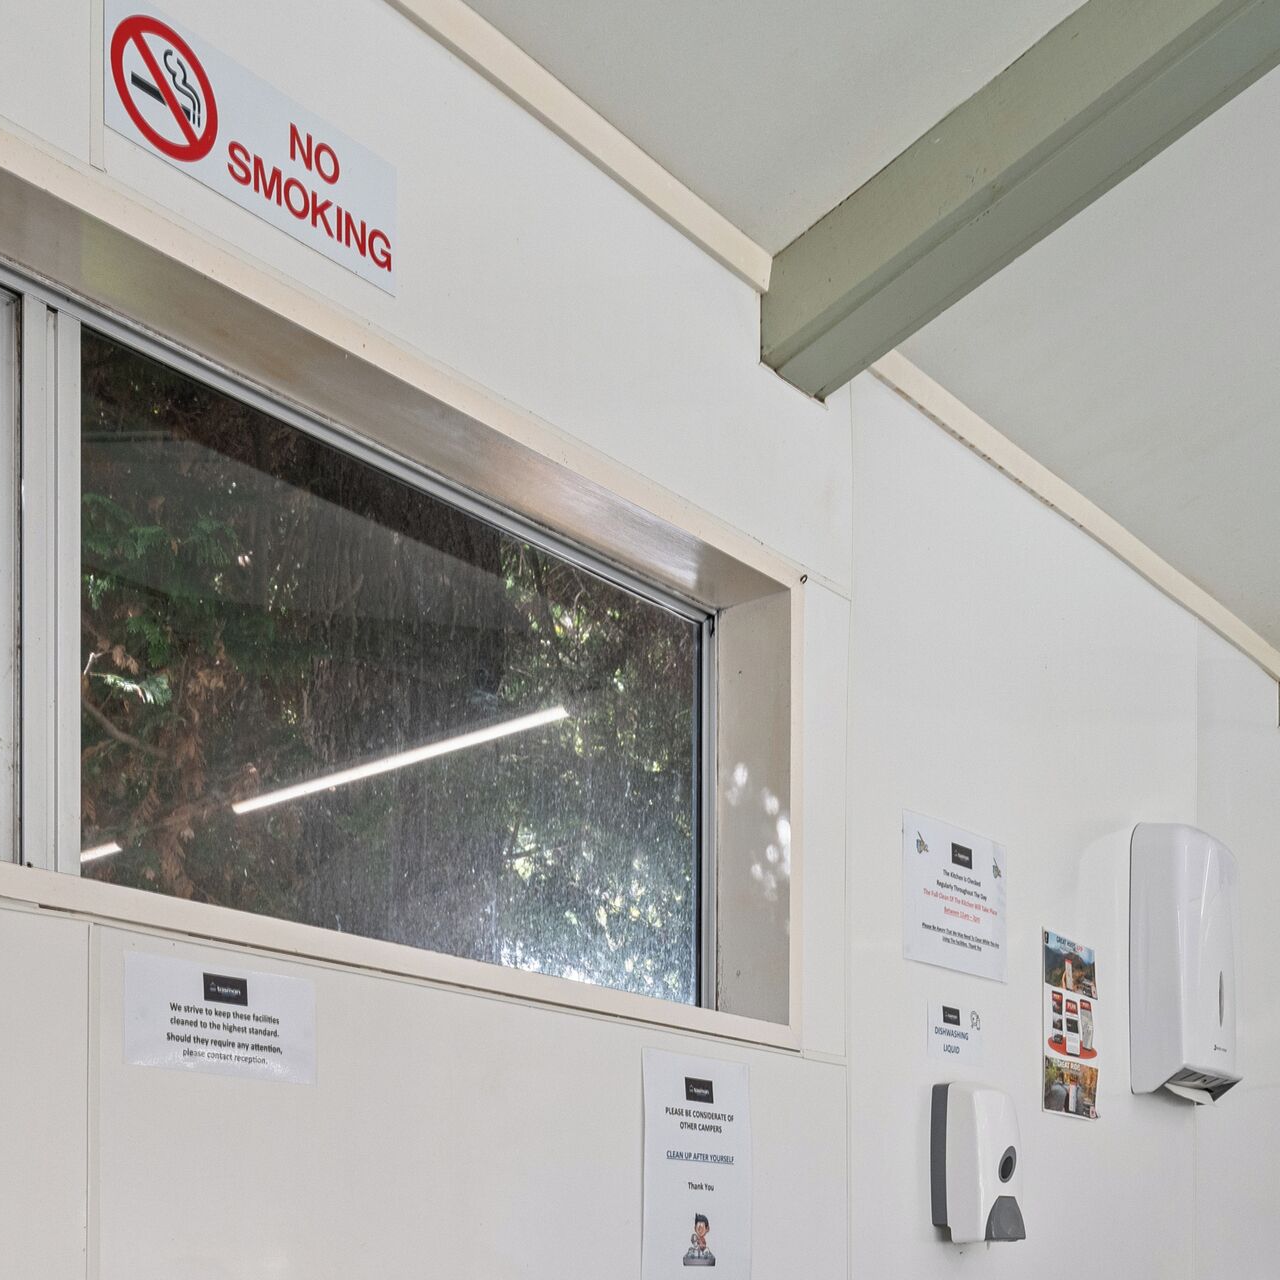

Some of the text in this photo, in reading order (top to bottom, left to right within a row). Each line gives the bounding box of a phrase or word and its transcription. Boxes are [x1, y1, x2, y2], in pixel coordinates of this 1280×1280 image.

[289, 121, 340, 185] NO
[227, 140, 392, 272] SMOKING
[169, 1002, 280, 1025] We strive to keep these facilities
[170, 1016, 280, 1038] cleaned to the highest standard.
[934, 1026, 969, 1041] DISHWASHING
[166, 1032, 283, 1055] Should they require any attention,
[943, 1043, 960, 1054] LIQUID
[182, 1048, 268, 1065] please contact reception.
[665, 1106, 734, 1122] PLEASE BE CONSIDERATE OF
[680, 1121, 723, 1134] OTHER CAMPERS
[666, 1150, 734, 1163] CLEAN UP AFTER YOURSELF
[688, 1182, 715, 1191] Thank You
